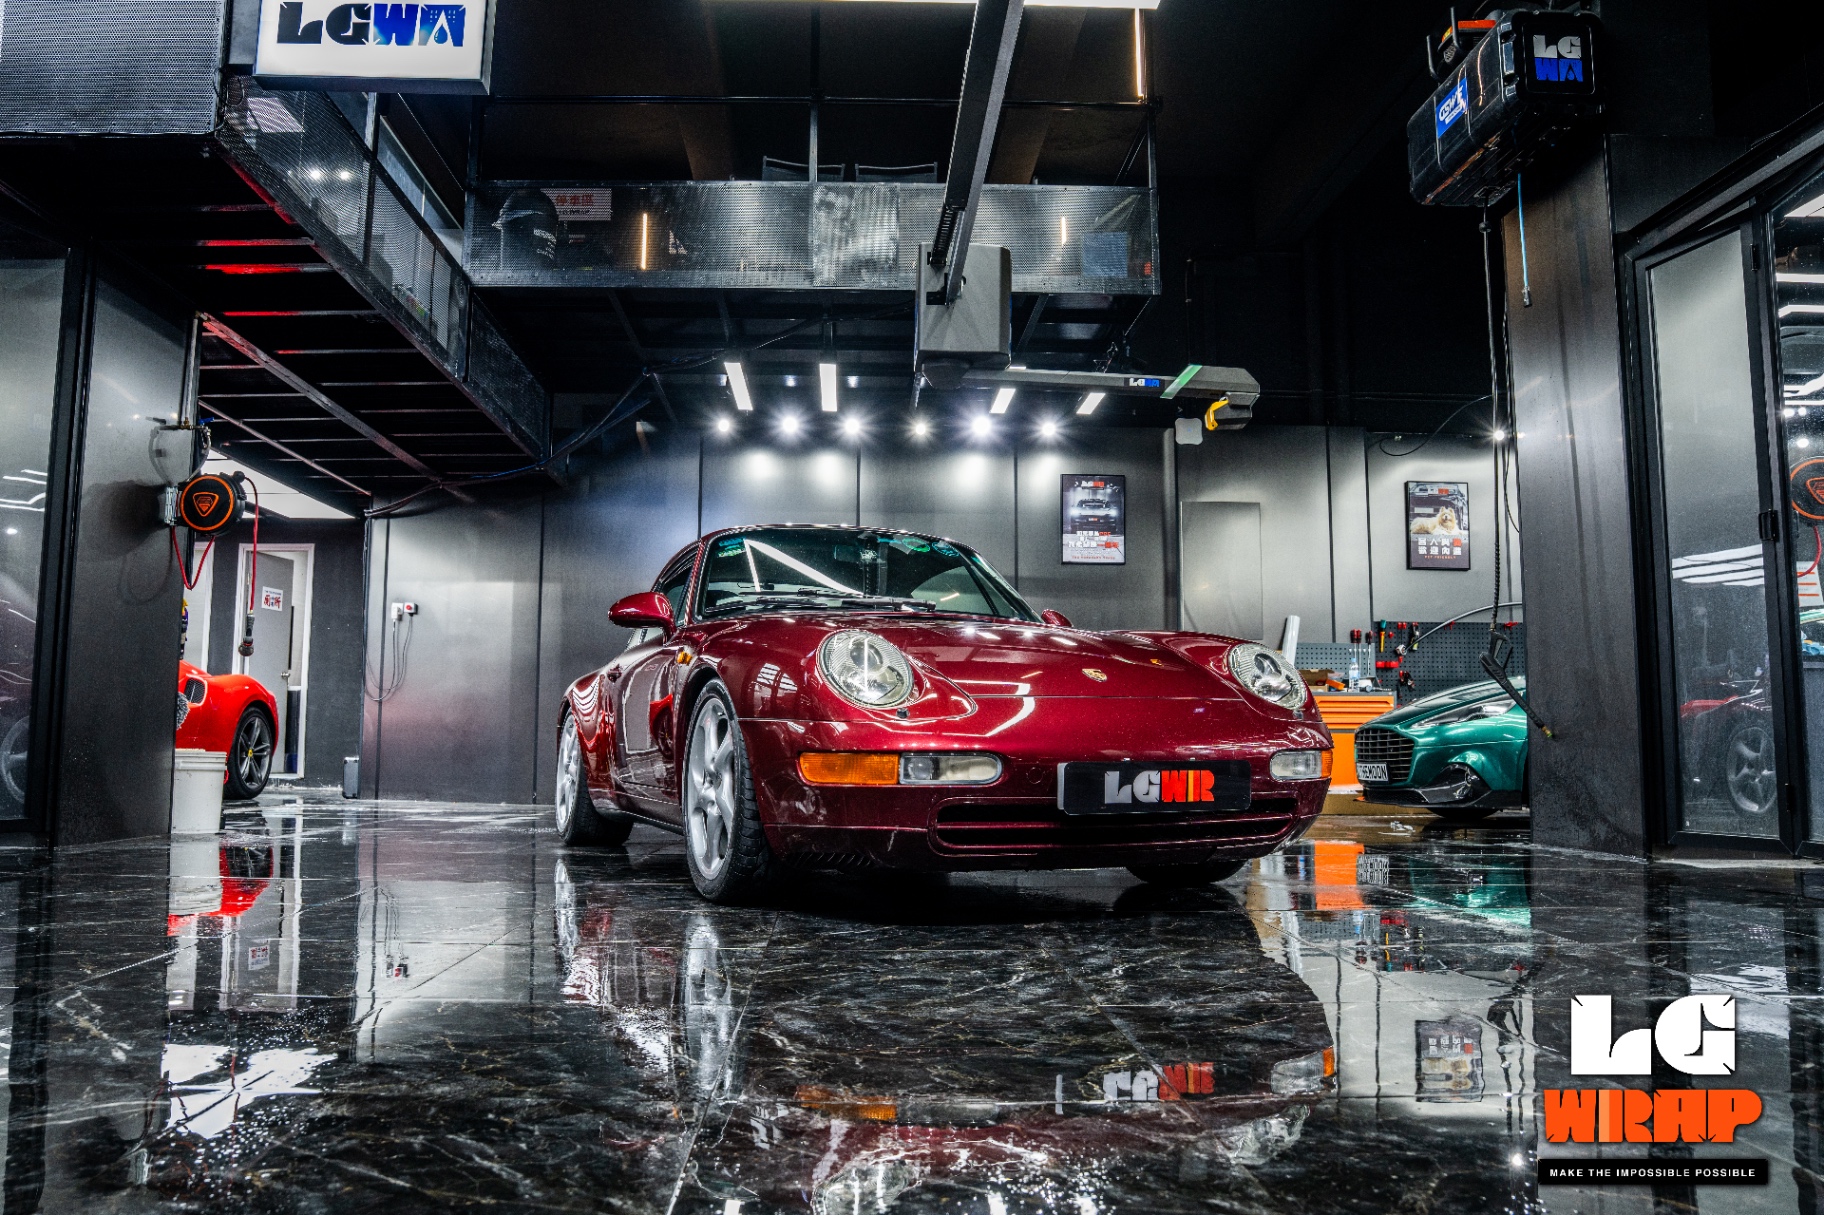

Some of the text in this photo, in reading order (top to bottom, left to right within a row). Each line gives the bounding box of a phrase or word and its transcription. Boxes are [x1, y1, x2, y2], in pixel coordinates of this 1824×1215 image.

[277, 2, 466, 47] LGWA
[1533, 35, 1581, 59] LG
[1535, 58, 1583, 82] WA
